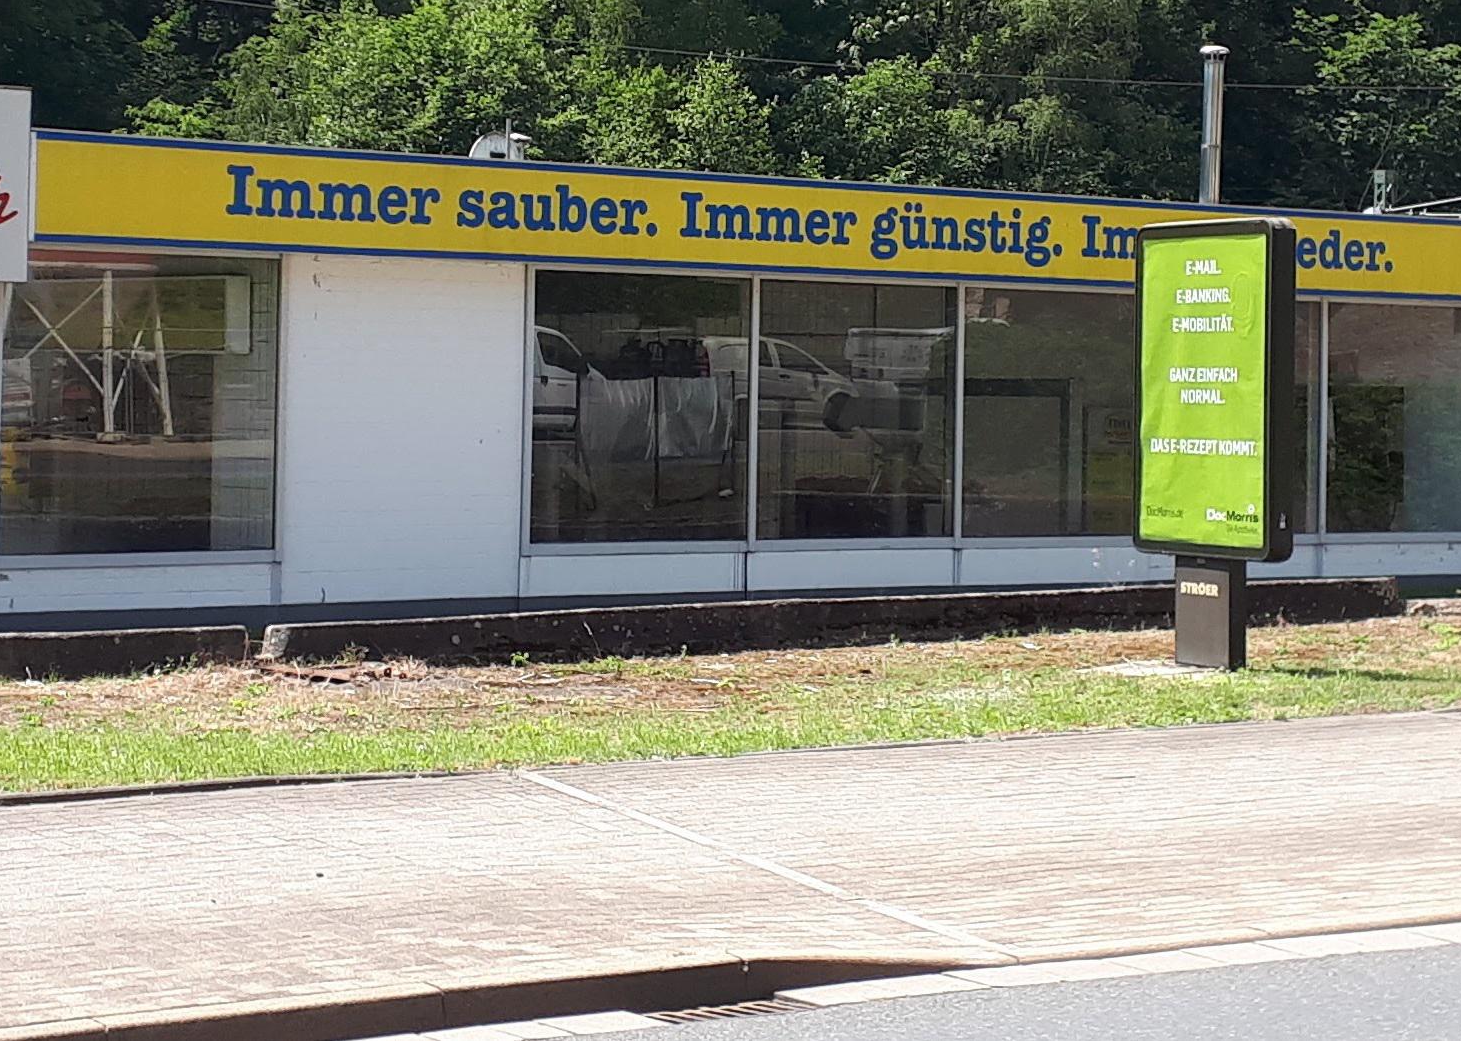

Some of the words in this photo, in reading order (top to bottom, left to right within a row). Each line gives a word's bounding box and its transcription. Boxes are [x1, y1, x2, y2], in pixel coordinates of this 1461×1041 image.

[225, 164, 440, 225] Immer
[456, 184, 658, 237] sauber.
[680, 192, 857, 245] Immer
[869, 202, 1063, 267] günstig.
[1185, 259, 1222, 276] E-MAIL.
[1176, 287, 1232, 304] E-BANKING.
[1172, 313, 1235, 333] E-MOBILITÄT.
[1169, 367, 1196, 383] GANZ
[1196, 367, 1238, 383] EINFACH
[1180, 389, 1226, 404] NORMAL.
[1150, 438, 1170, 454] DAS
[1170, 439, 1218, 455] E-REZEPT
[1218, 440, 1258, 456] KOMMT.
[1180, 581, 1218, 598] STRÖER
